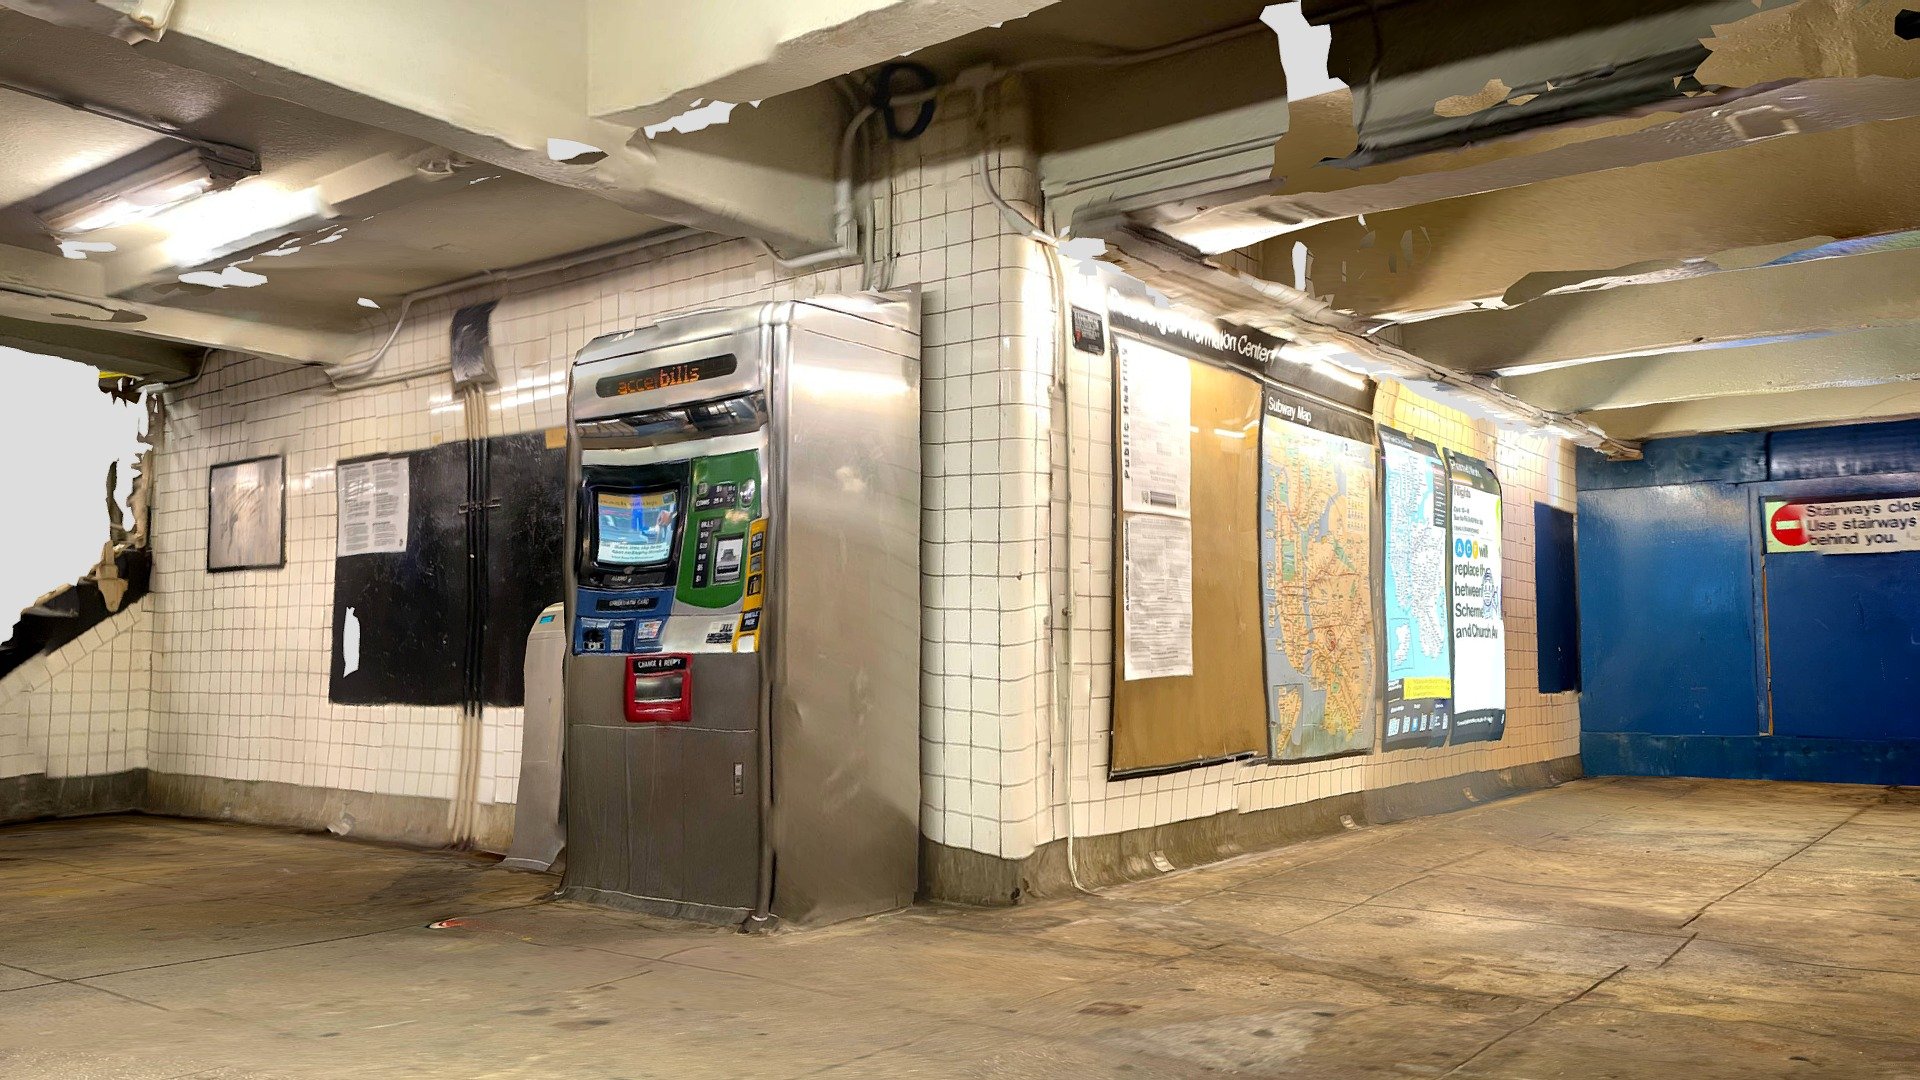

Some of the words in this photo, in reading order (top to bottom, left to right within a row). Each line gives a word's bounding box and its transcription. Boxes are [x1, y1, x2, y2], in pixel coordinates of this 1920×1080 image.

[1237, 335, 1271, 363] Center
[659, 364, 700, 388] bills
[1268, 396, 1296, 421] Subway
[1297, 405, 1312, 426] Map
[1807, 502, 1881, 517] Stairways
[1807, 520, 1836, 531] Use
[1842, 516, 1917, 530] stairways
[1808, 532, 1859, 546] behind
[1865, 534, 1897, 546] you.
[1455, 561, 1479, 578] replace
[1456, 623, 1471, 638] and
[1472, 623, 1491, 638] Church
